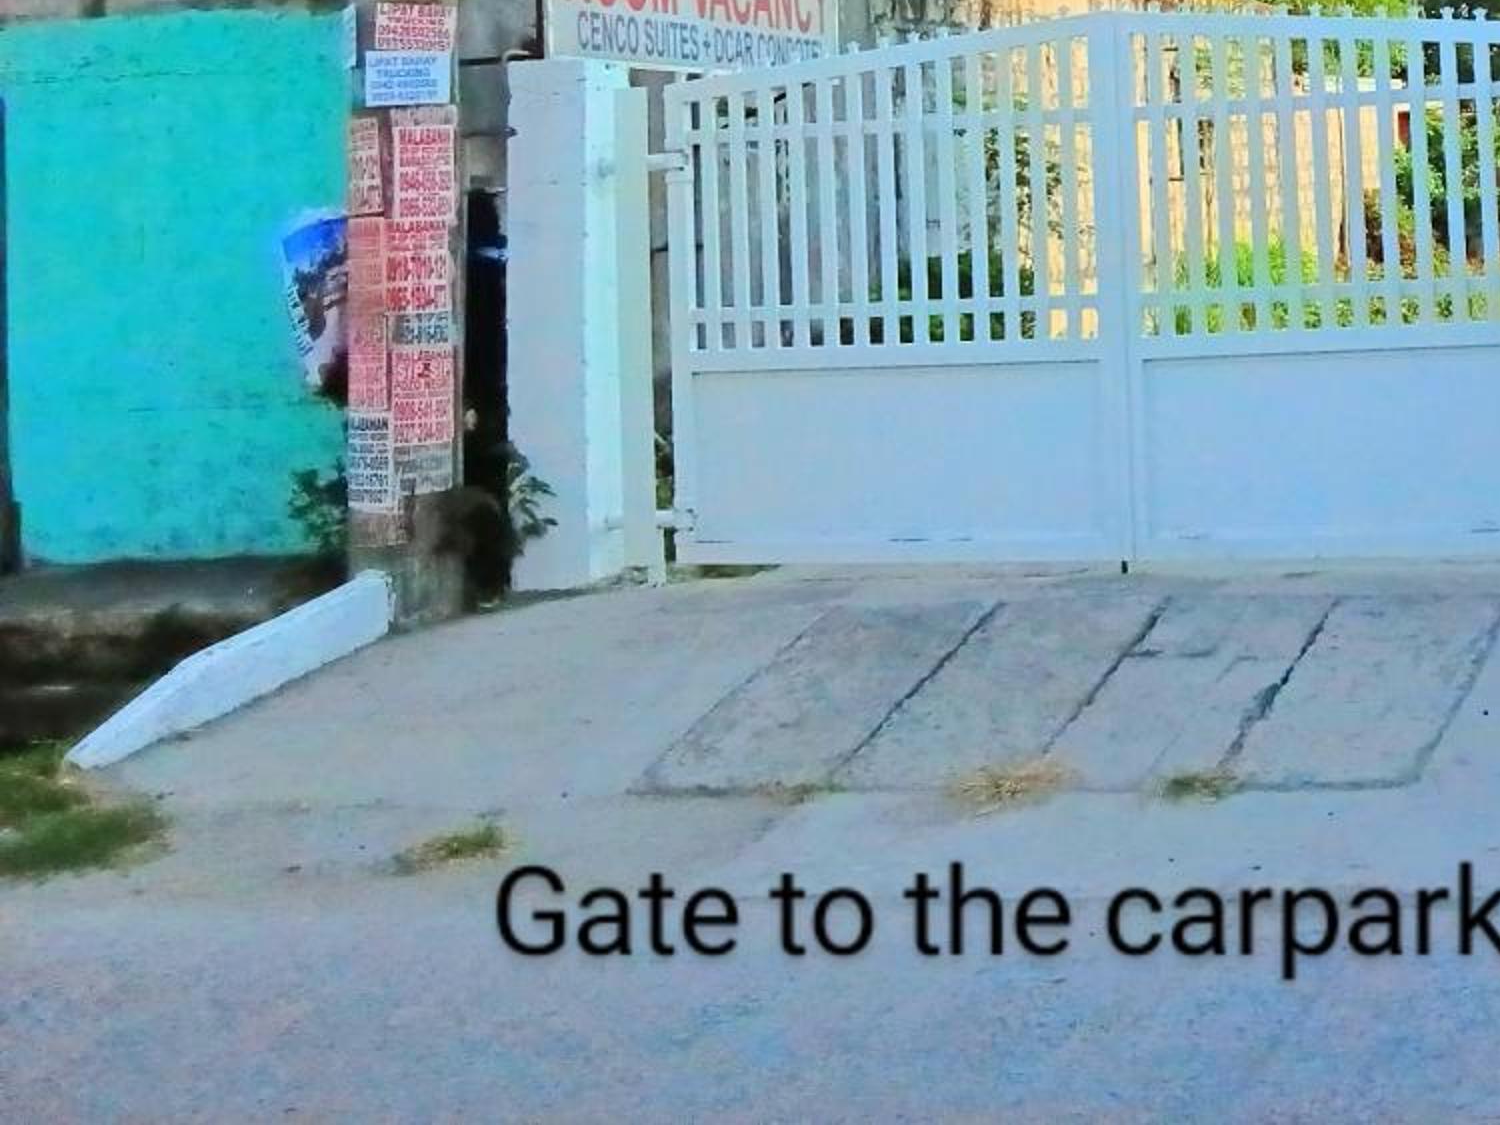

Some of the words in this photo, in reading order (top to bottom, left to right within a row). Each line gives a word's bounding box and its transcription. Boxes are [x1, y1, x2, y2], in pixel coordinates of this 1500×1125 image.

[378, 1, 411, 17] LIPAT
[577, 10, 639, 55] CENCO
[645, 22, 699, 62] SUITES
[713, 26, 755, 67] DCAR
[367, 57, 398, 69] LIPAT
[376, 67, 432, 79] TRUCKING
